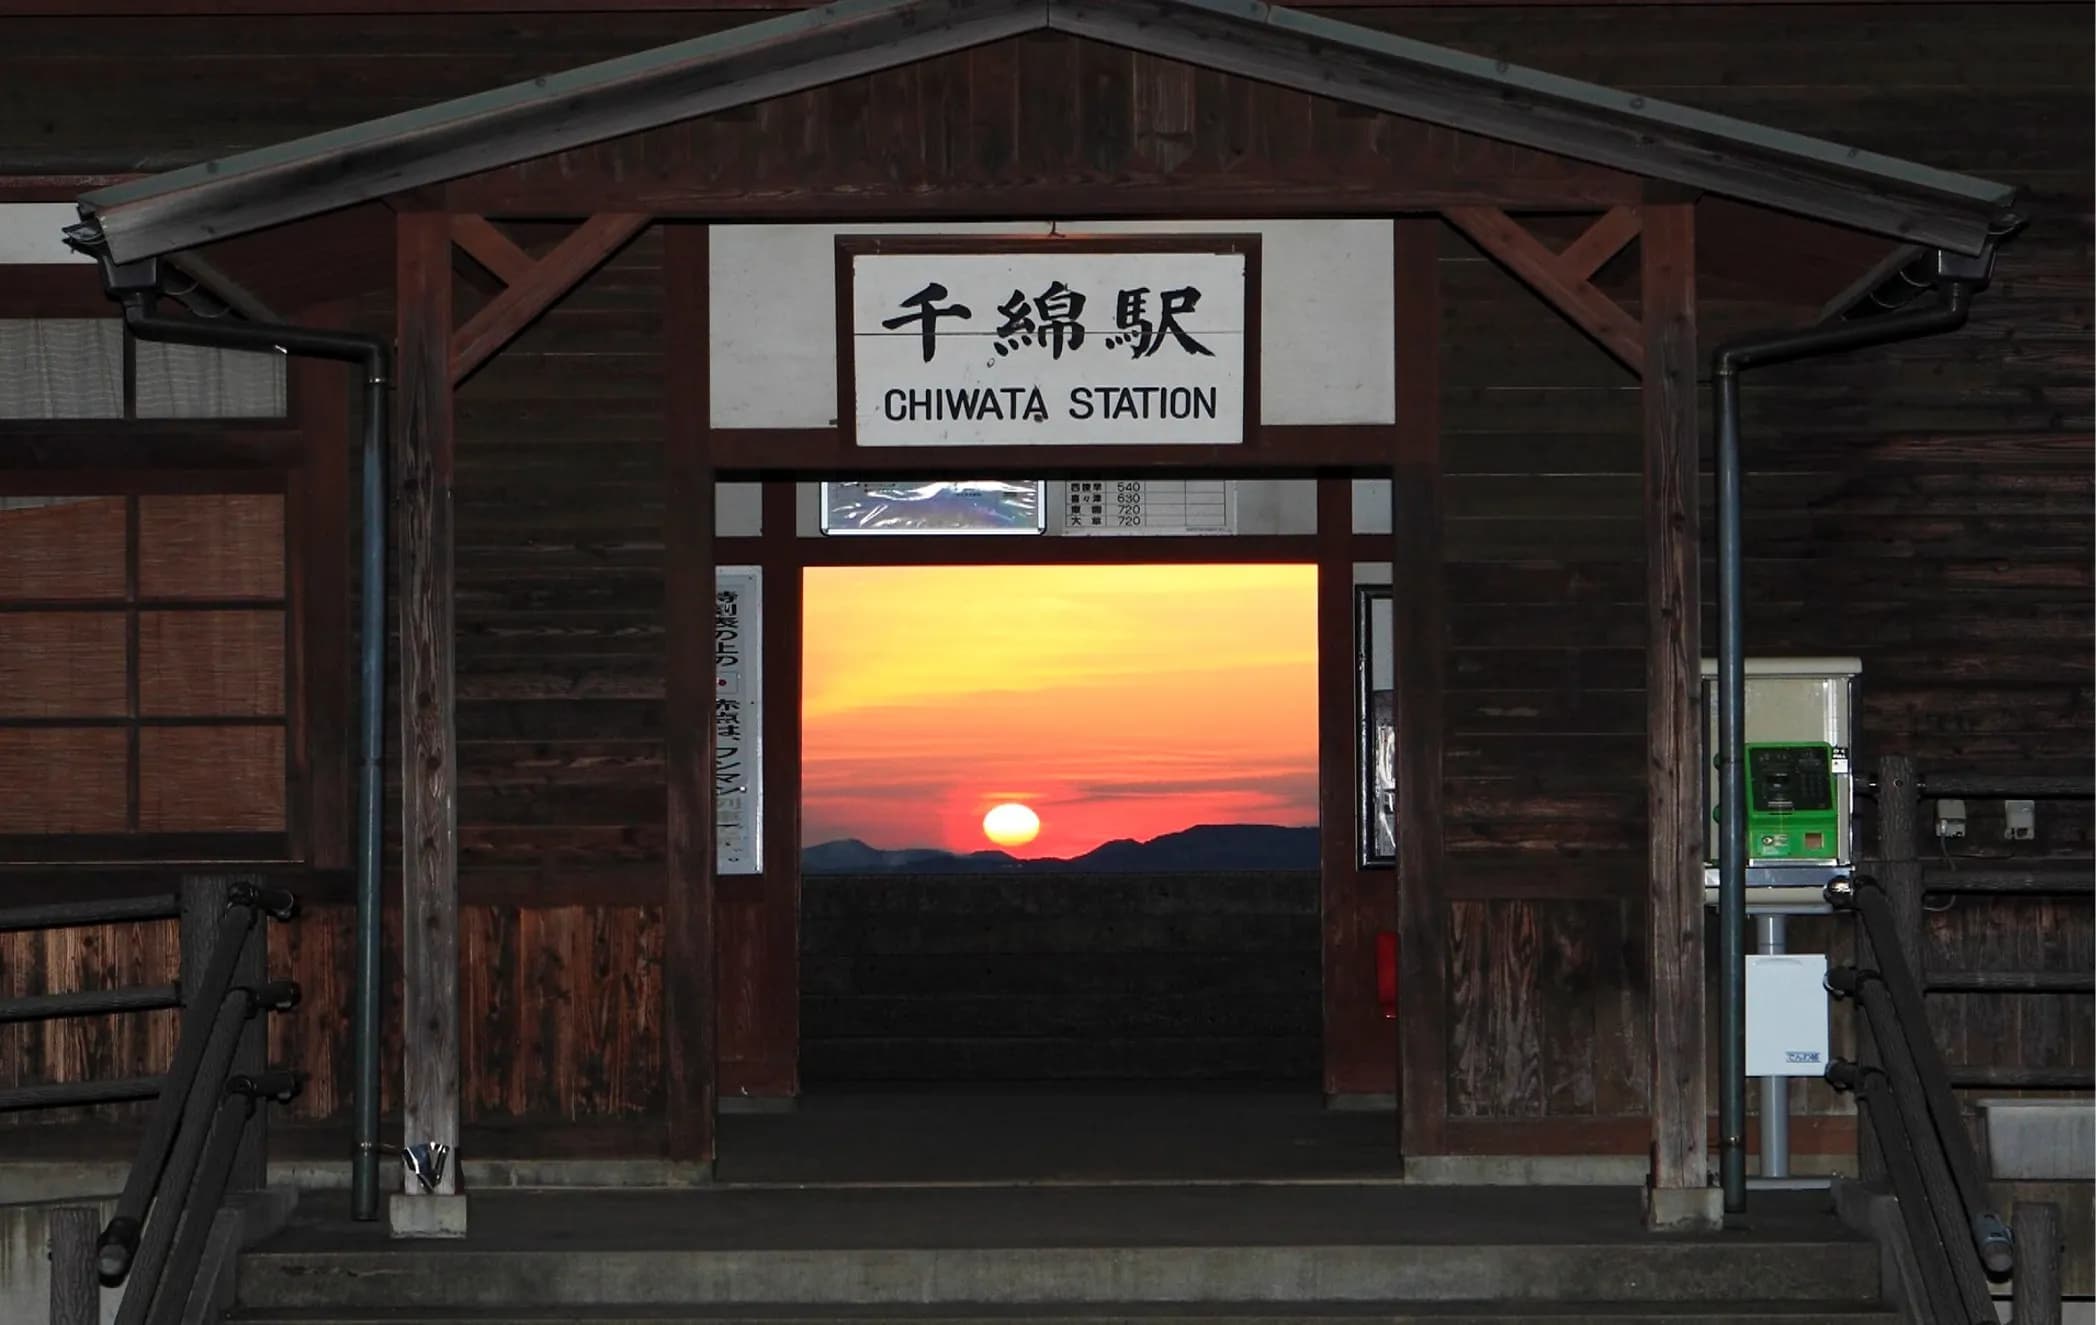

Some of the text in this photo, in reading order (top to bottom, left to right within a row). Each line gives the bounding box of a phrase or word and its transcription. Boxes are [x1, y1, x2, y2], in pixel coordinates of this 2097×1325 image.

[882, 281, 1215, 363] 千綿駅
[884, 386, 1217, 422] CHIWATA STATION
[1117, 482, 1141, 492] 540
[1117, 493, 1141, 503] 630
[1118, 504, 1141, 515] 720
[1118, 516, 1141, 527] 720
